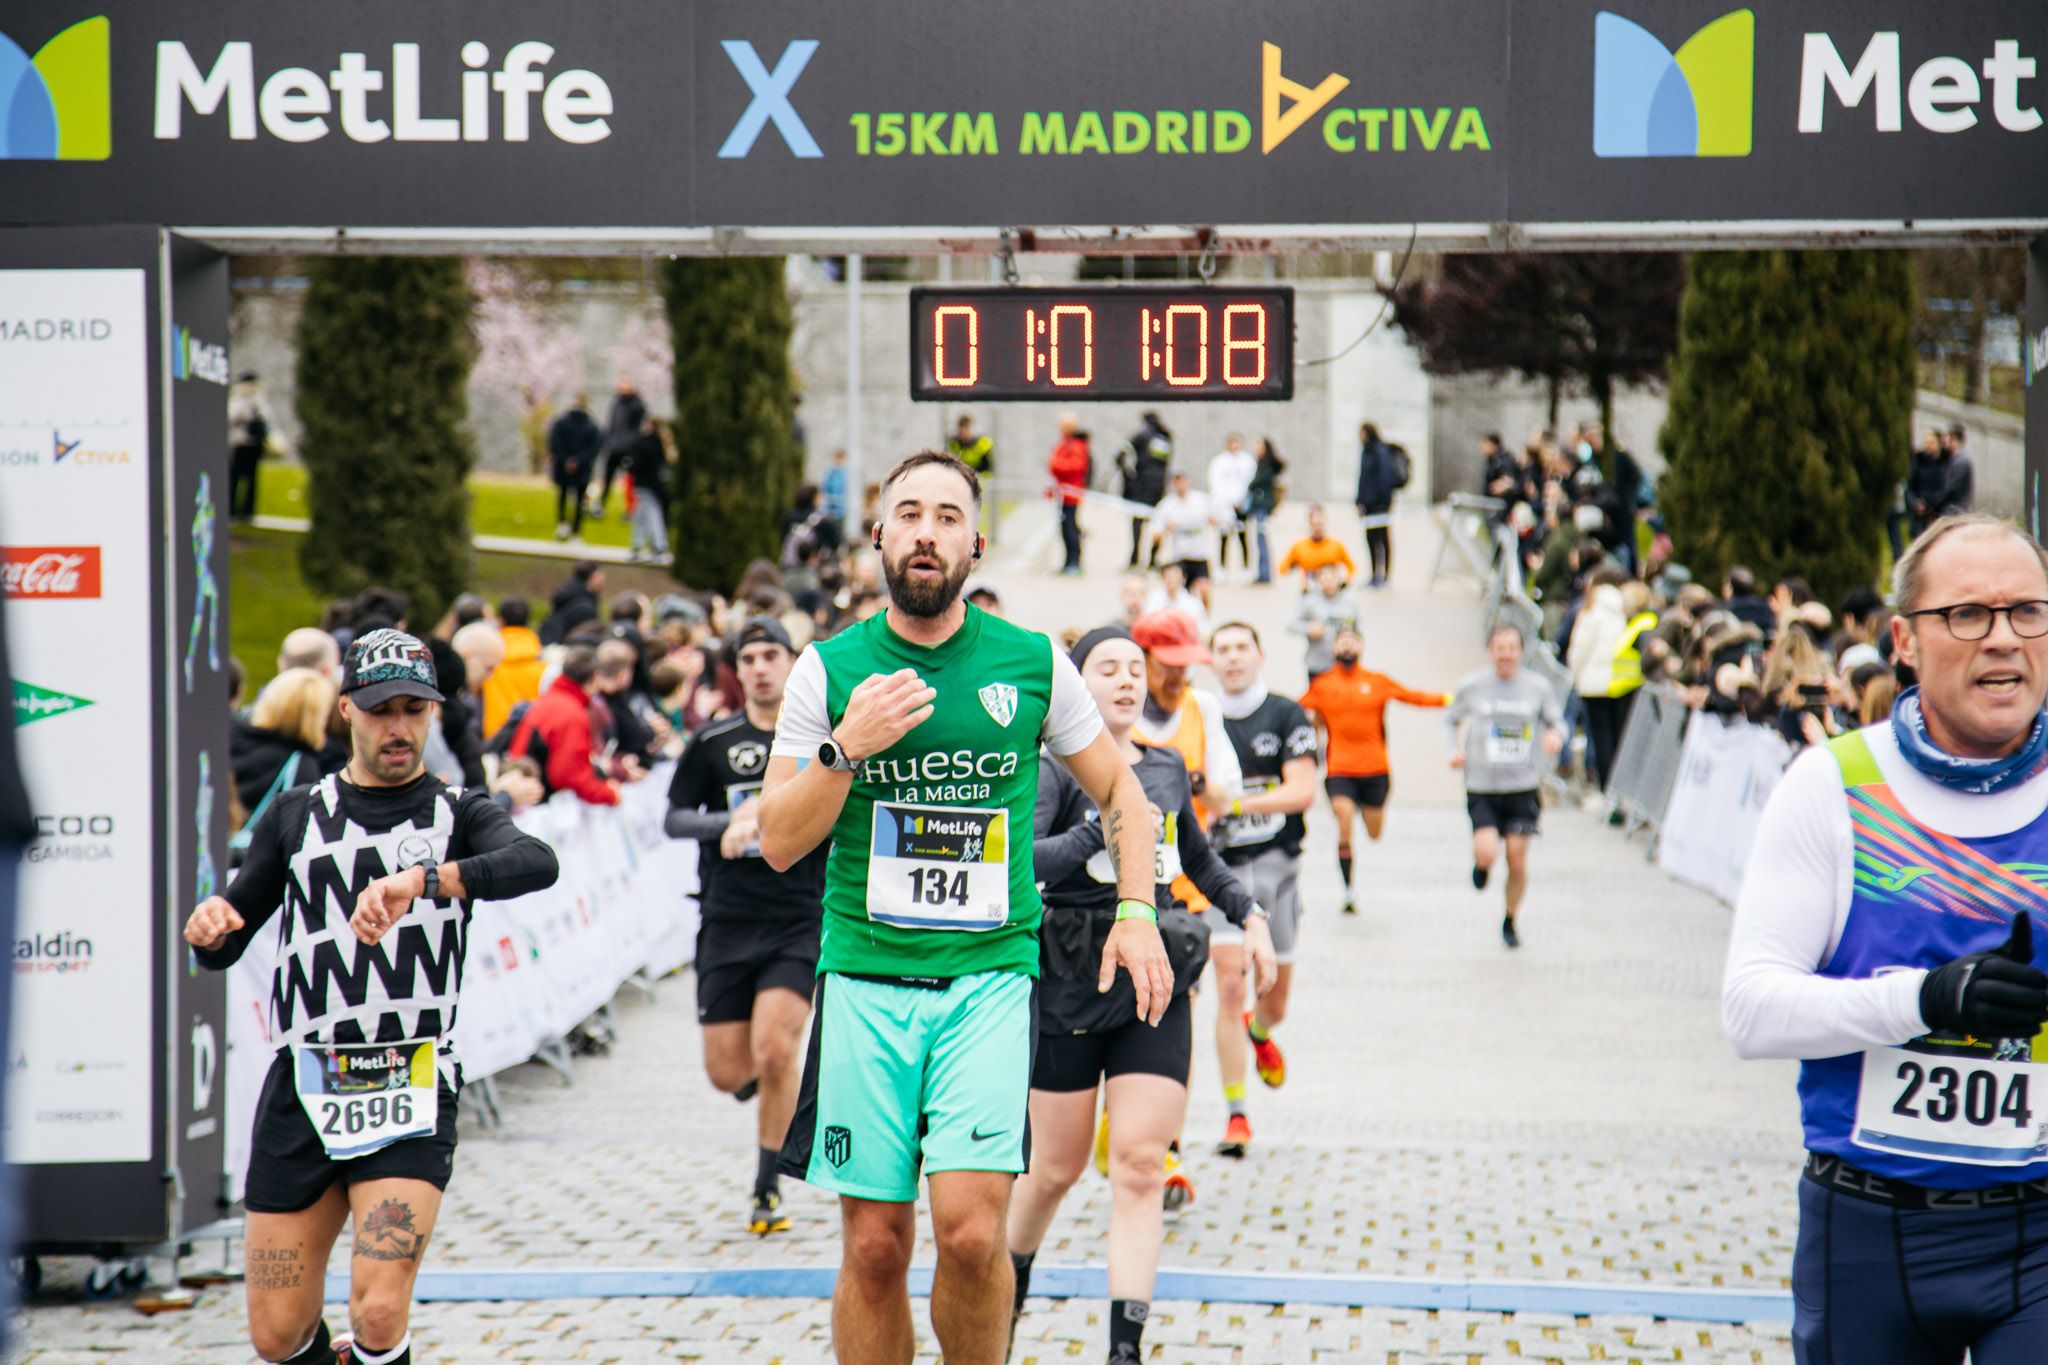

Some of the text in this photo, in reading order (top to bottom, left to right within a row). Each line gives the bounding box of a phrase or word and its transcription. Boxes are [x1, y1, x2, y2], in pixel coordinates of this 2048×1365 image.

[154, 40, 614, 144] MetLife
[717, 40, 824, 158] X
[849, 112, 998, 156] 15KM
[1798, 31, 2044, 133] Met
[927, 819, 982, 836] MetLife
[908, 867, 969, 907] 134
[350, 1055, 406, 1071] MetLife
[322, 1093, 412, 1135] 2696
[1892, 1061, 2032, 1128] 2304
